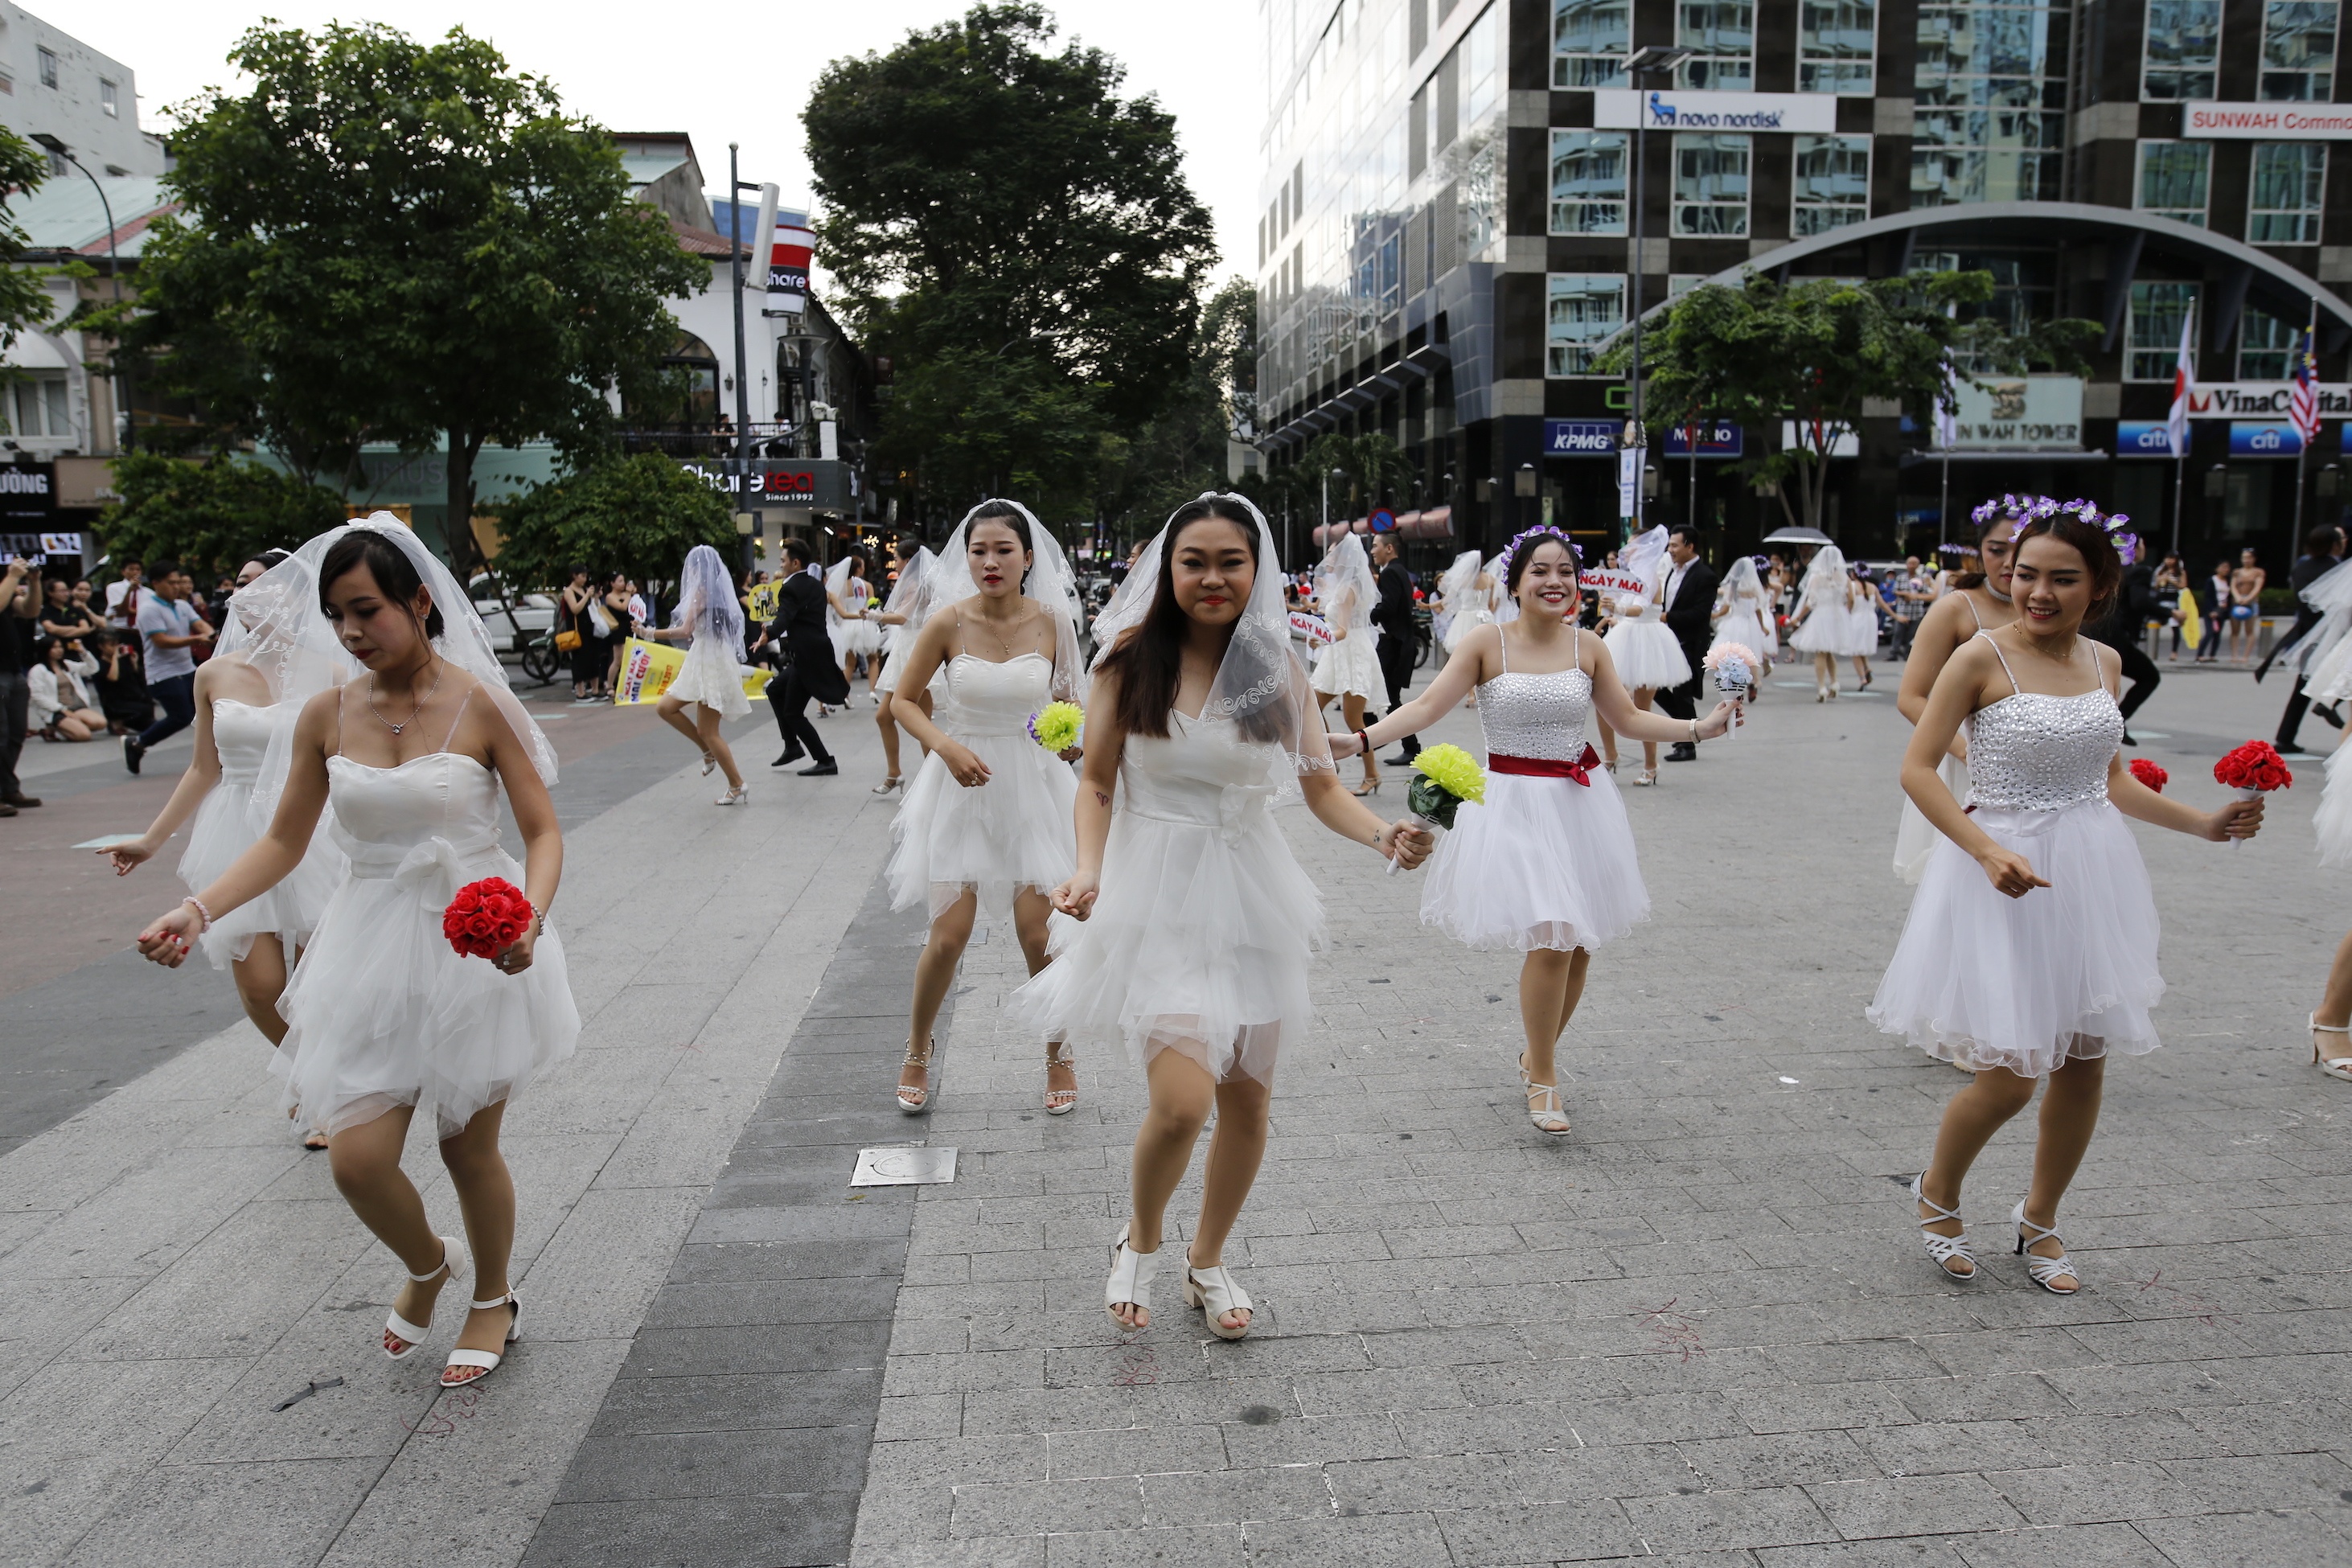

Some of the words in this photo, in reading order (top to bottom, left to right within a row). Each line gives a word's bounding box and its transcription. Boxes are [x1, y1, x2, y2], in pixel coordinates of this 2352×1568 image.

[1680, 113, 1719, 126] novo
[1723, 110, 1781, 128] nordisk
[2192, 111, 2278, 129] SUNWAH
[1977, 424, 2015, 440] WAH
[2021, 424, 2078, 440] TOWER
[1554, 434, 1609, 449] KPMG
[2250, 432, 2280, 449] citi
[765, 493, 790, 502] Since
[790, 493, 814, 502] 1992
[1579, 574, 1615, 587] NGÀY
[1618, 579, 1644, 593] MAI
[1315, 626, 1332, 642] MAI
